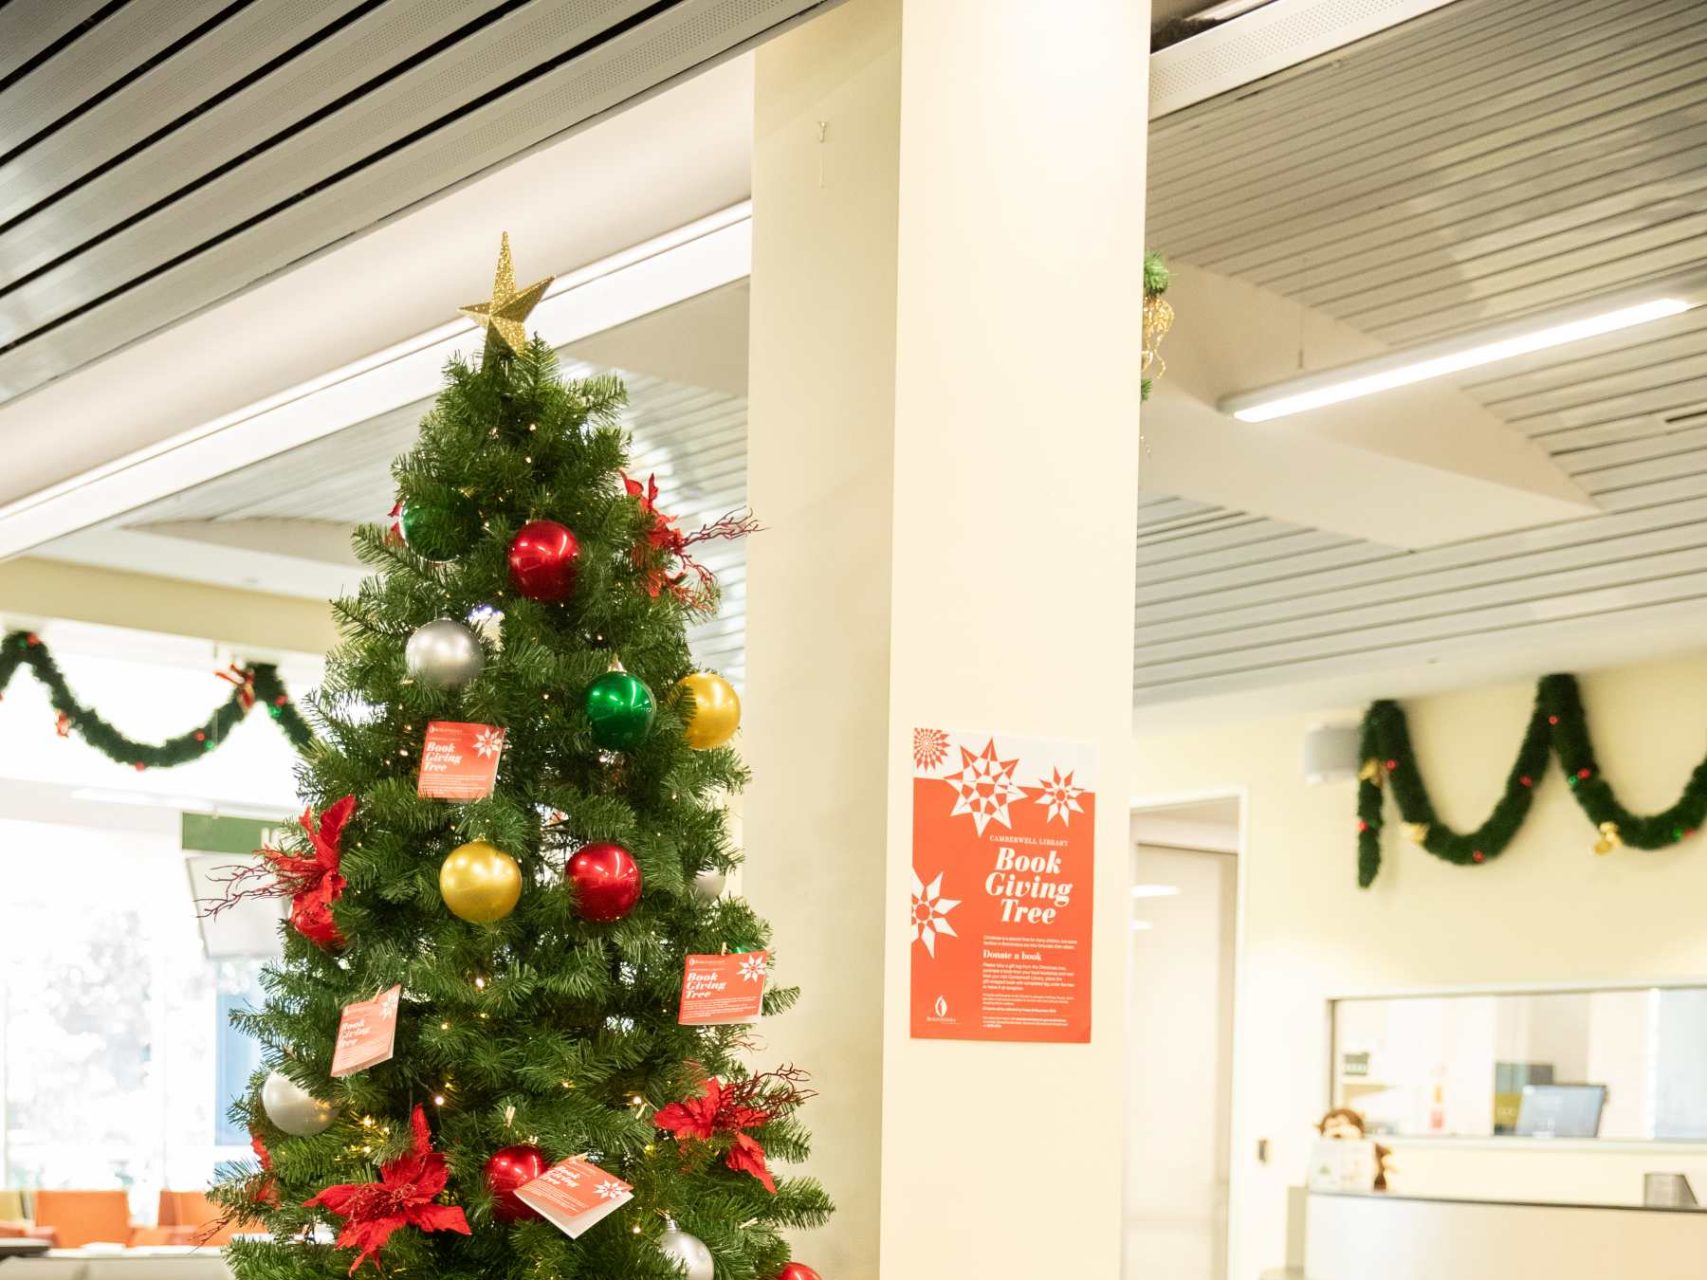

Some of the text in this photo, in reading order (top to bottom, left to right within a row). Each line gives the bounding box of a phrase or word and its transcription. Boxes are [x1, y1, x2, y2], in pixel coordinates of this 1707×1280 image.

[989, 835, 1069, 847] CAMBERWELL LIBRARY
[995, 846, 1062, 874] Book
[985, 871, 1073, 908] Giving
[1000, 898, 1056, 925] Tree
[983, 949, 1013, 960] Donate
[1021, 951, 1042, 961] book
[687, 971, 718, 982] Book
